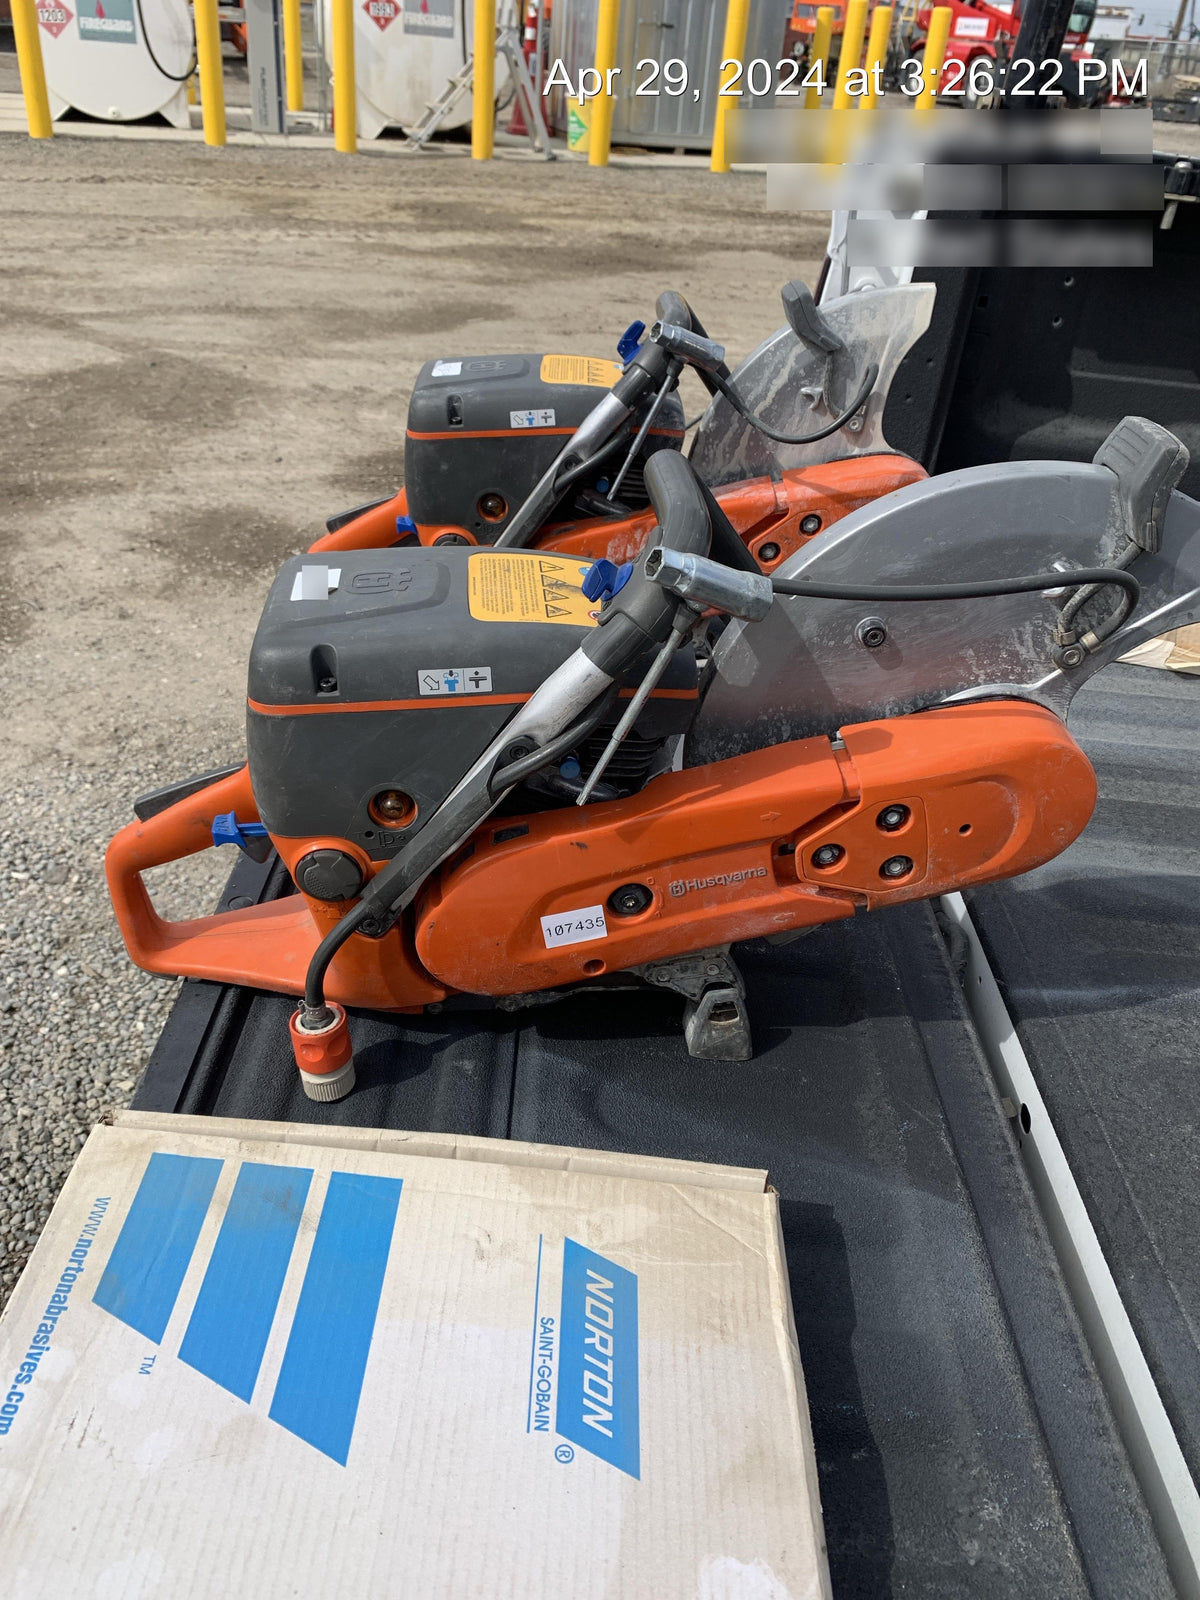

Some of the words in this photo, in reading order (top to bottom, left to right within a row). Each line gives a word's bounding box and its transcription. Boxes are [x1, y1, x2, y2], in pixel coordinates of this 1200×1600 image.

[686, 866, 767, 893] Husqvarna
[546, 917, 605, 937] 107435
[534, 1316, 555, 1432] SAINT-GOBAIN
[582, 1268, 614, 1438] NORTON
